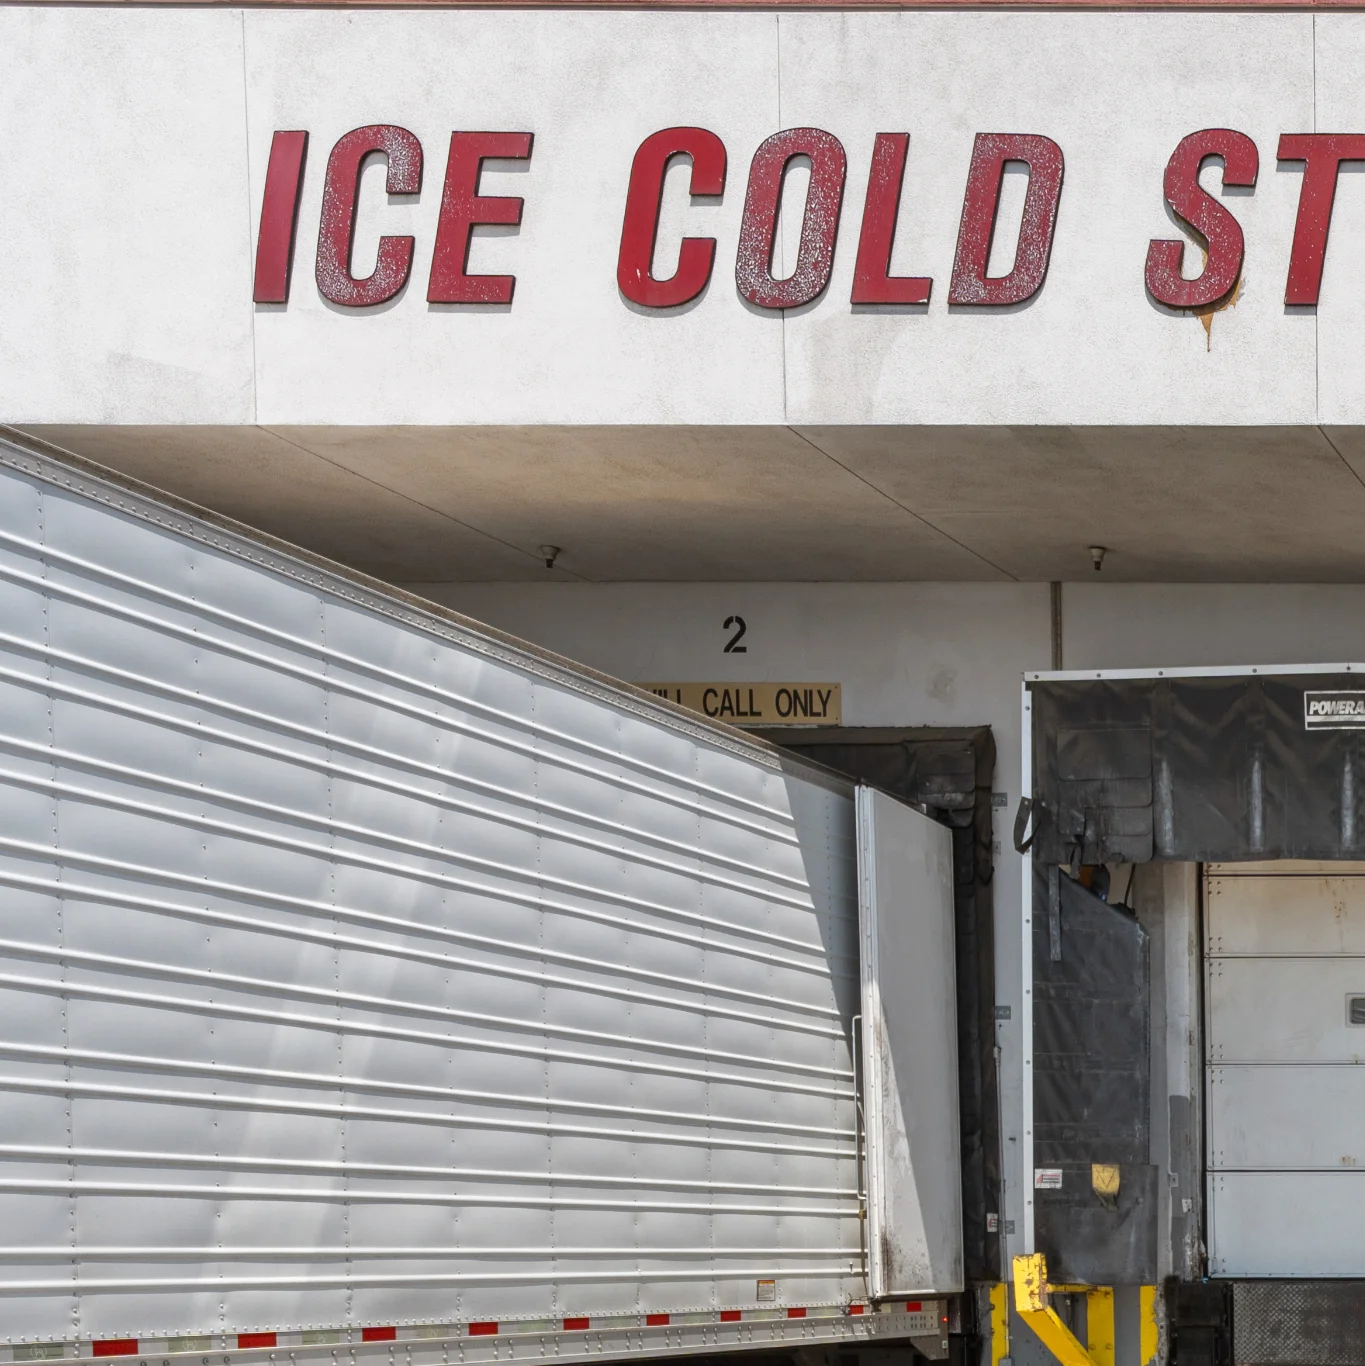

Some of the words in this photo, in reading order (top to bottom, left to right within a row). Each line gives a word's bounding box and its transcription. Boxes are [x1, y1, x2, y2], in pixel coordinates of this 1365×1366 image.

[254, 125, 534, 307] ICE
[616, 126, 1065, 309] COLD
[723, 615, 747, 653] 2
[702, 688, 762, 717] CALL
[775, 688, 832, 717] ONLY
